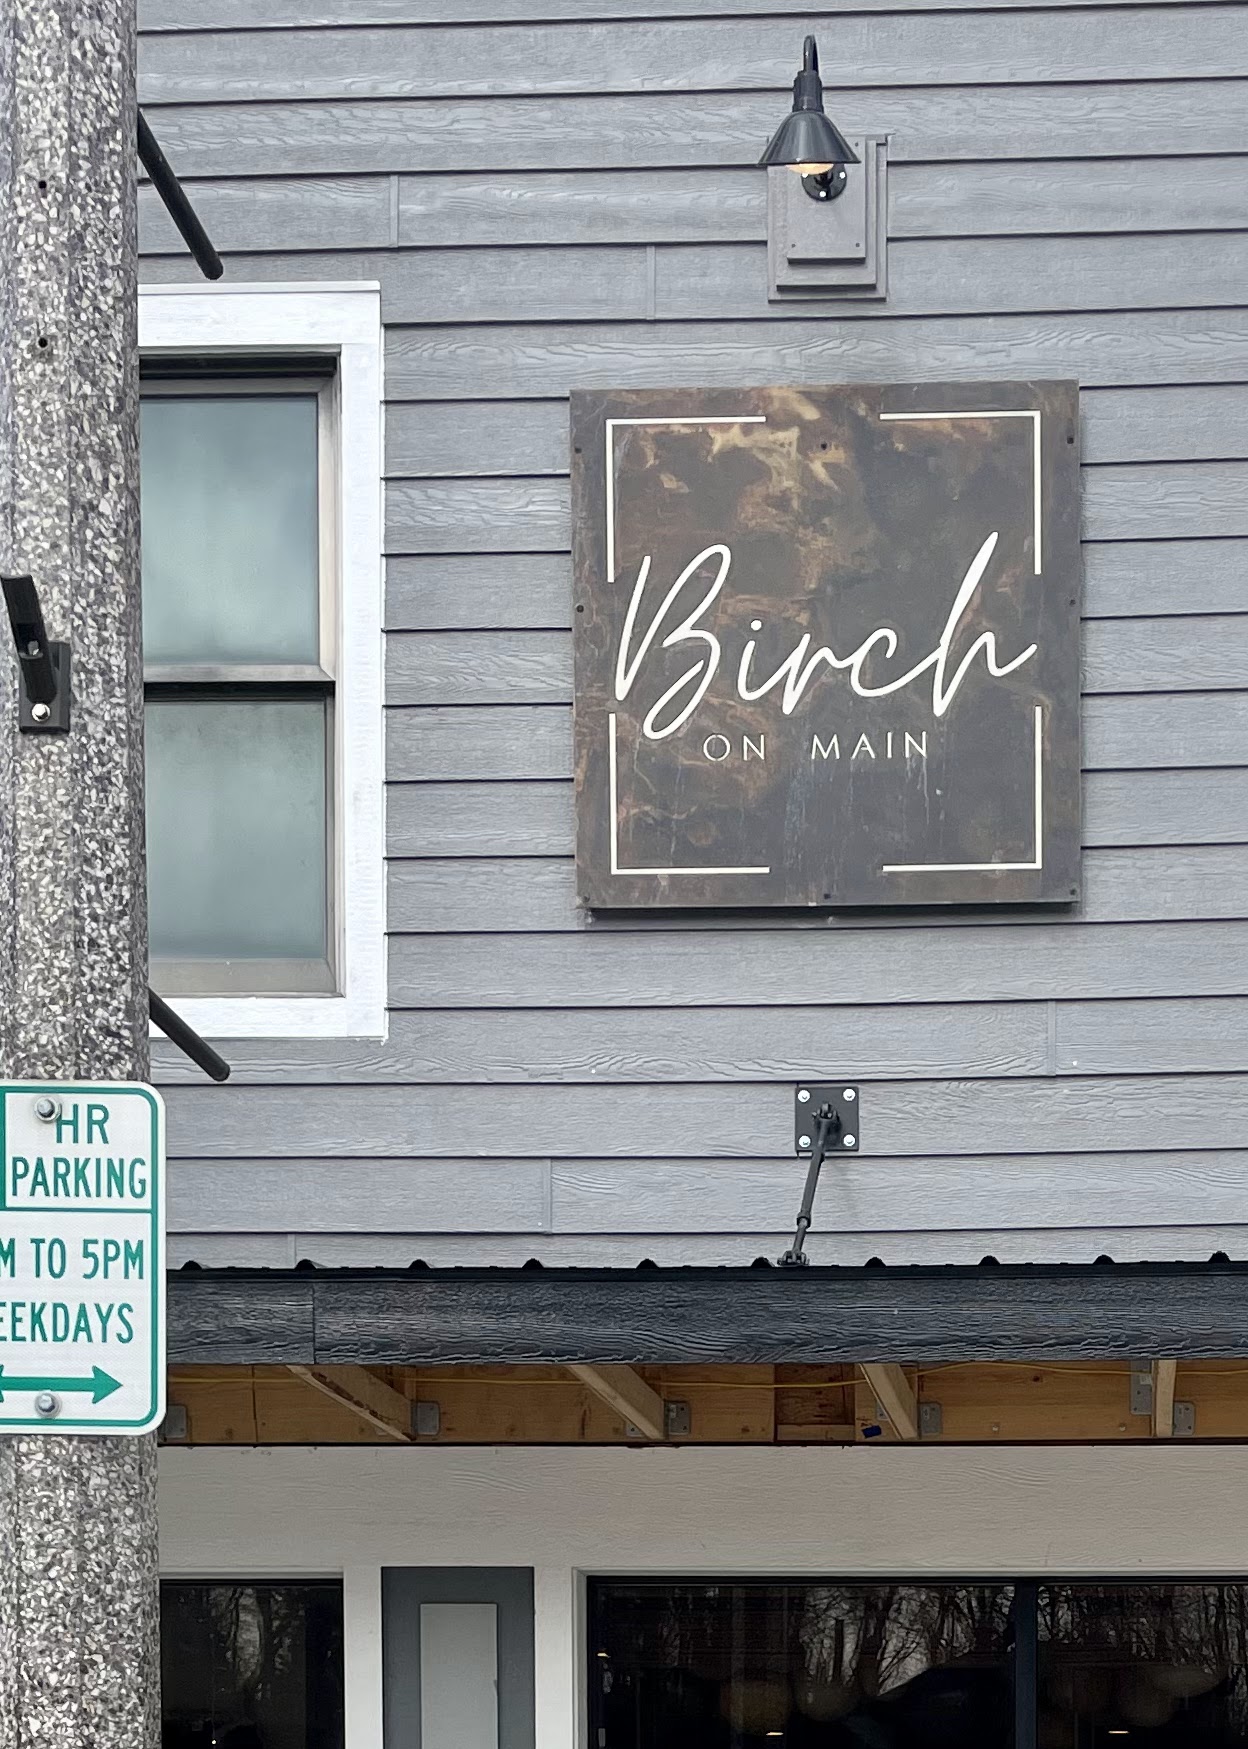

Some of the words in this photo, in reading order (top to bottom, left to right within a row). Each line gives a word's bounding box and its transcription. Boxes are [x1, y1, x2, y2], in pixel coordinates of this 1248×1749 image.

[614, 531, 1038, 739] Birch
[703, 733, 766, 762] ON
[811, 731, 928, 761] MAIN
[56, 1103, 109, 1145] HR
[11, 1156, 147, 1199] PARKING
[30, 1237, 66, 1280] TO
[82, 1238, 144, 1280] 5PM
